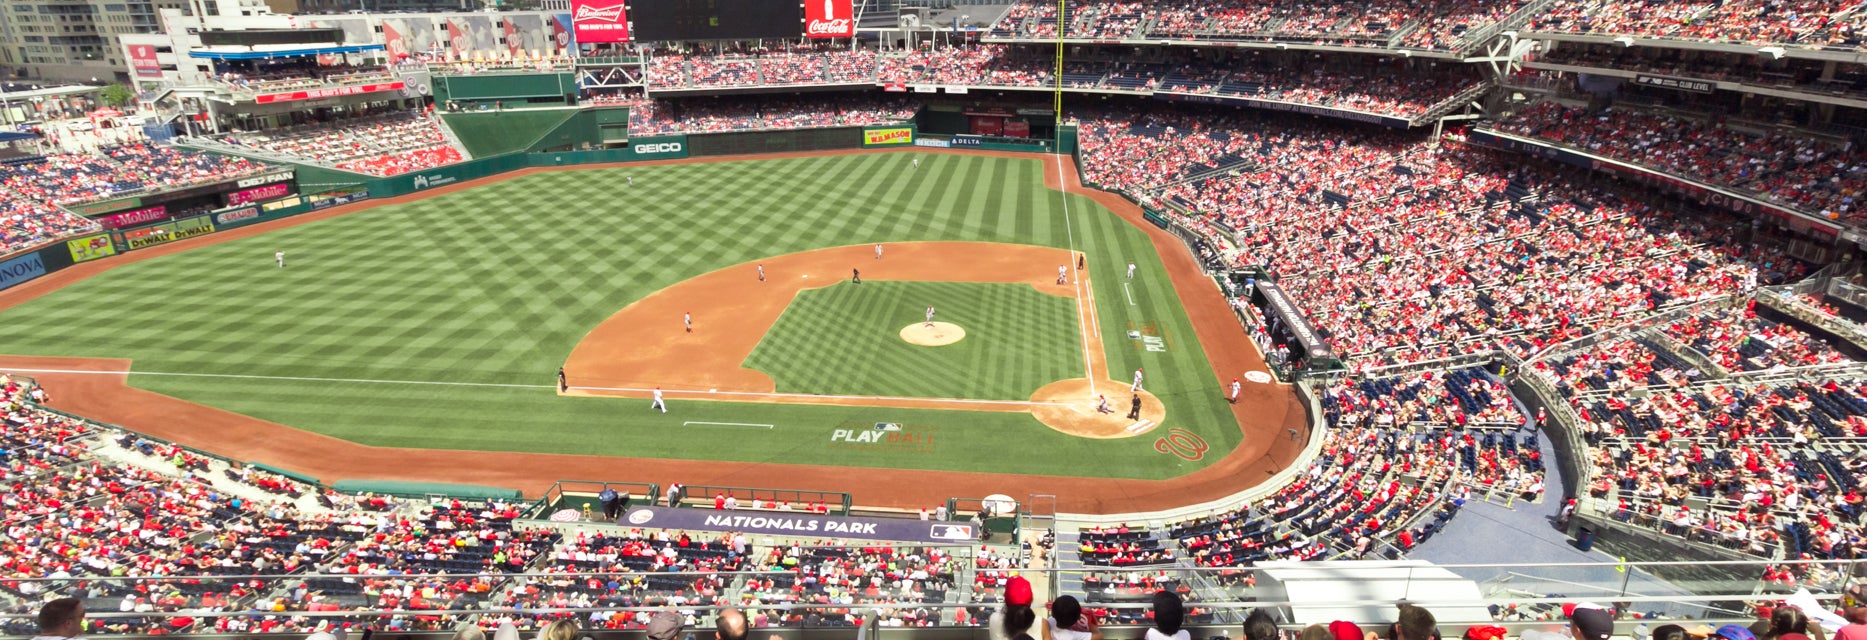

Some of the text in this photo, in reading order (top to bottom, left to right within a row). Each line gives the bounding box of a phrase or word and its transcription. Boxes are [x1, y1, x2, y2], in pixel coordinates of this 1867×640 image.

[577, 8, 619, 17] Budweiser
[809, 19, 850, 34] Coca-Cola
[1679, 80, 1693, 89] CLUB
[1693, 82, 1709, 91] LEVEL
[635, 142, 682, 154] GEICO
[267, 172, 294, 183] FAN
[831, 429, 885, 443] PLAY
[1154, 428, 1210, 461] W
[704, 515, 878, 535] NATIONALS PARK
